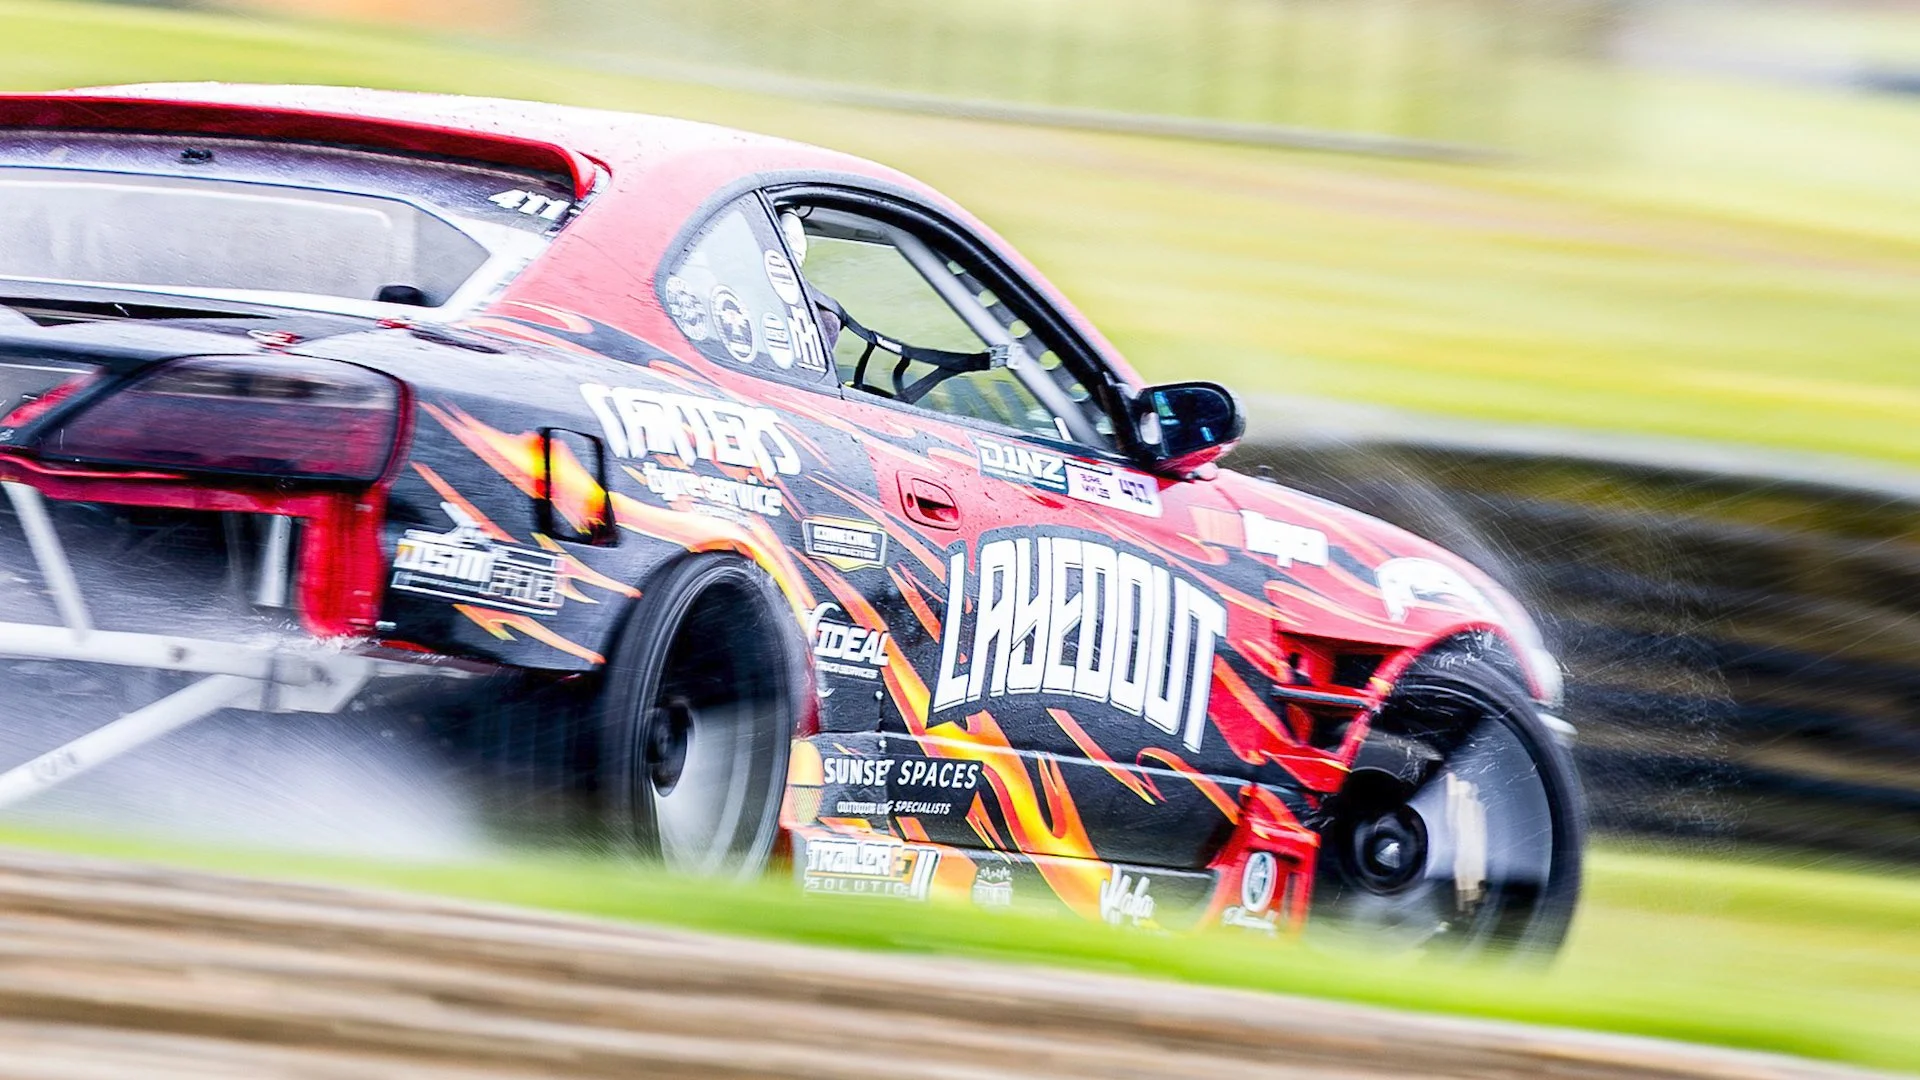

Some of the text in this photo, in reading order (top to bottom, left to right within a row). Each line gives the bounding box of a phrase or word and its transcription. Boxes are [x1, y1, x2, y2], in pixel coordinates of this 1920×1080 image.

[487, 189, 571, 219] 411
[976, 438, 1067, 483] D1NZ
[814, 622, 889, 666] IDEAL
[824, 757, 980, 789] SUNSET SPACES
[893, 801, 951, 815] SPECIALISTS
